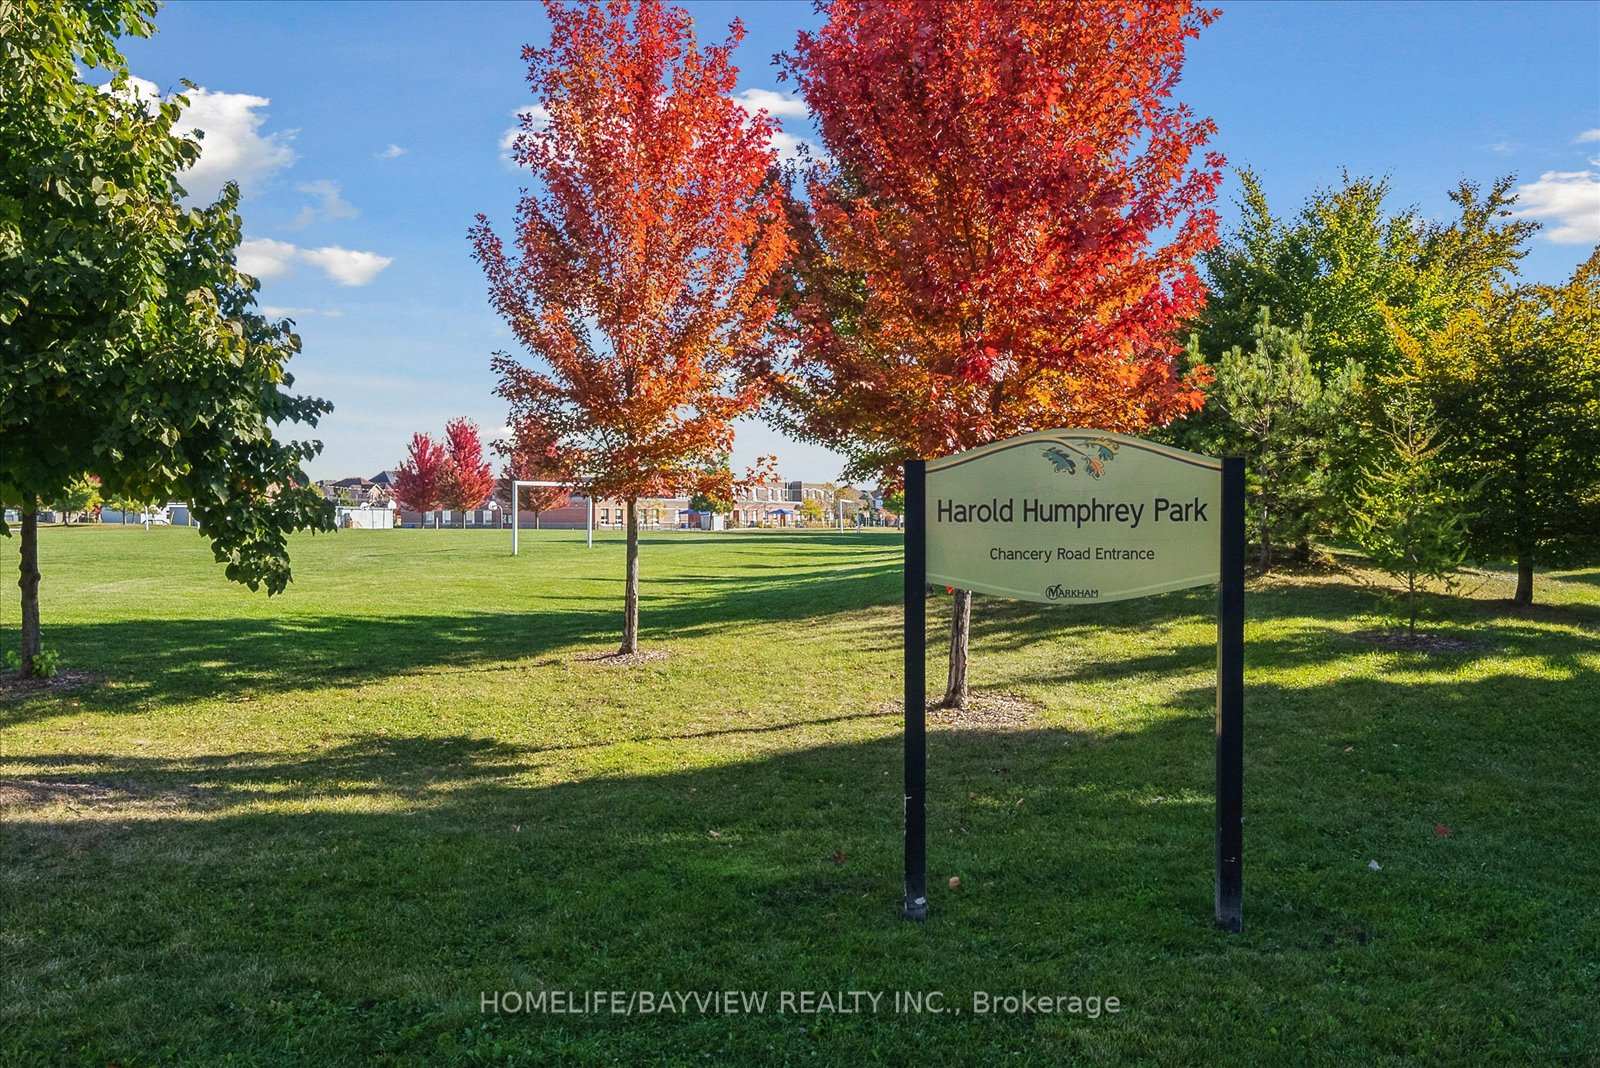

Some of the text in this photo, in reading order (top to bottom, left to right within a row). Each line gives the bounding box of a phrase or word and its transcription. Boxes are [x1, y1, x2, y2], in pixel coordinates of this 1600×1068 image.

[937, 497, 1209, 528] Harold Humphrey Park
[990, 547, 1155, 563] Chancery Road Entrance
[1045, 584, 1099, 600] MARKHAM
